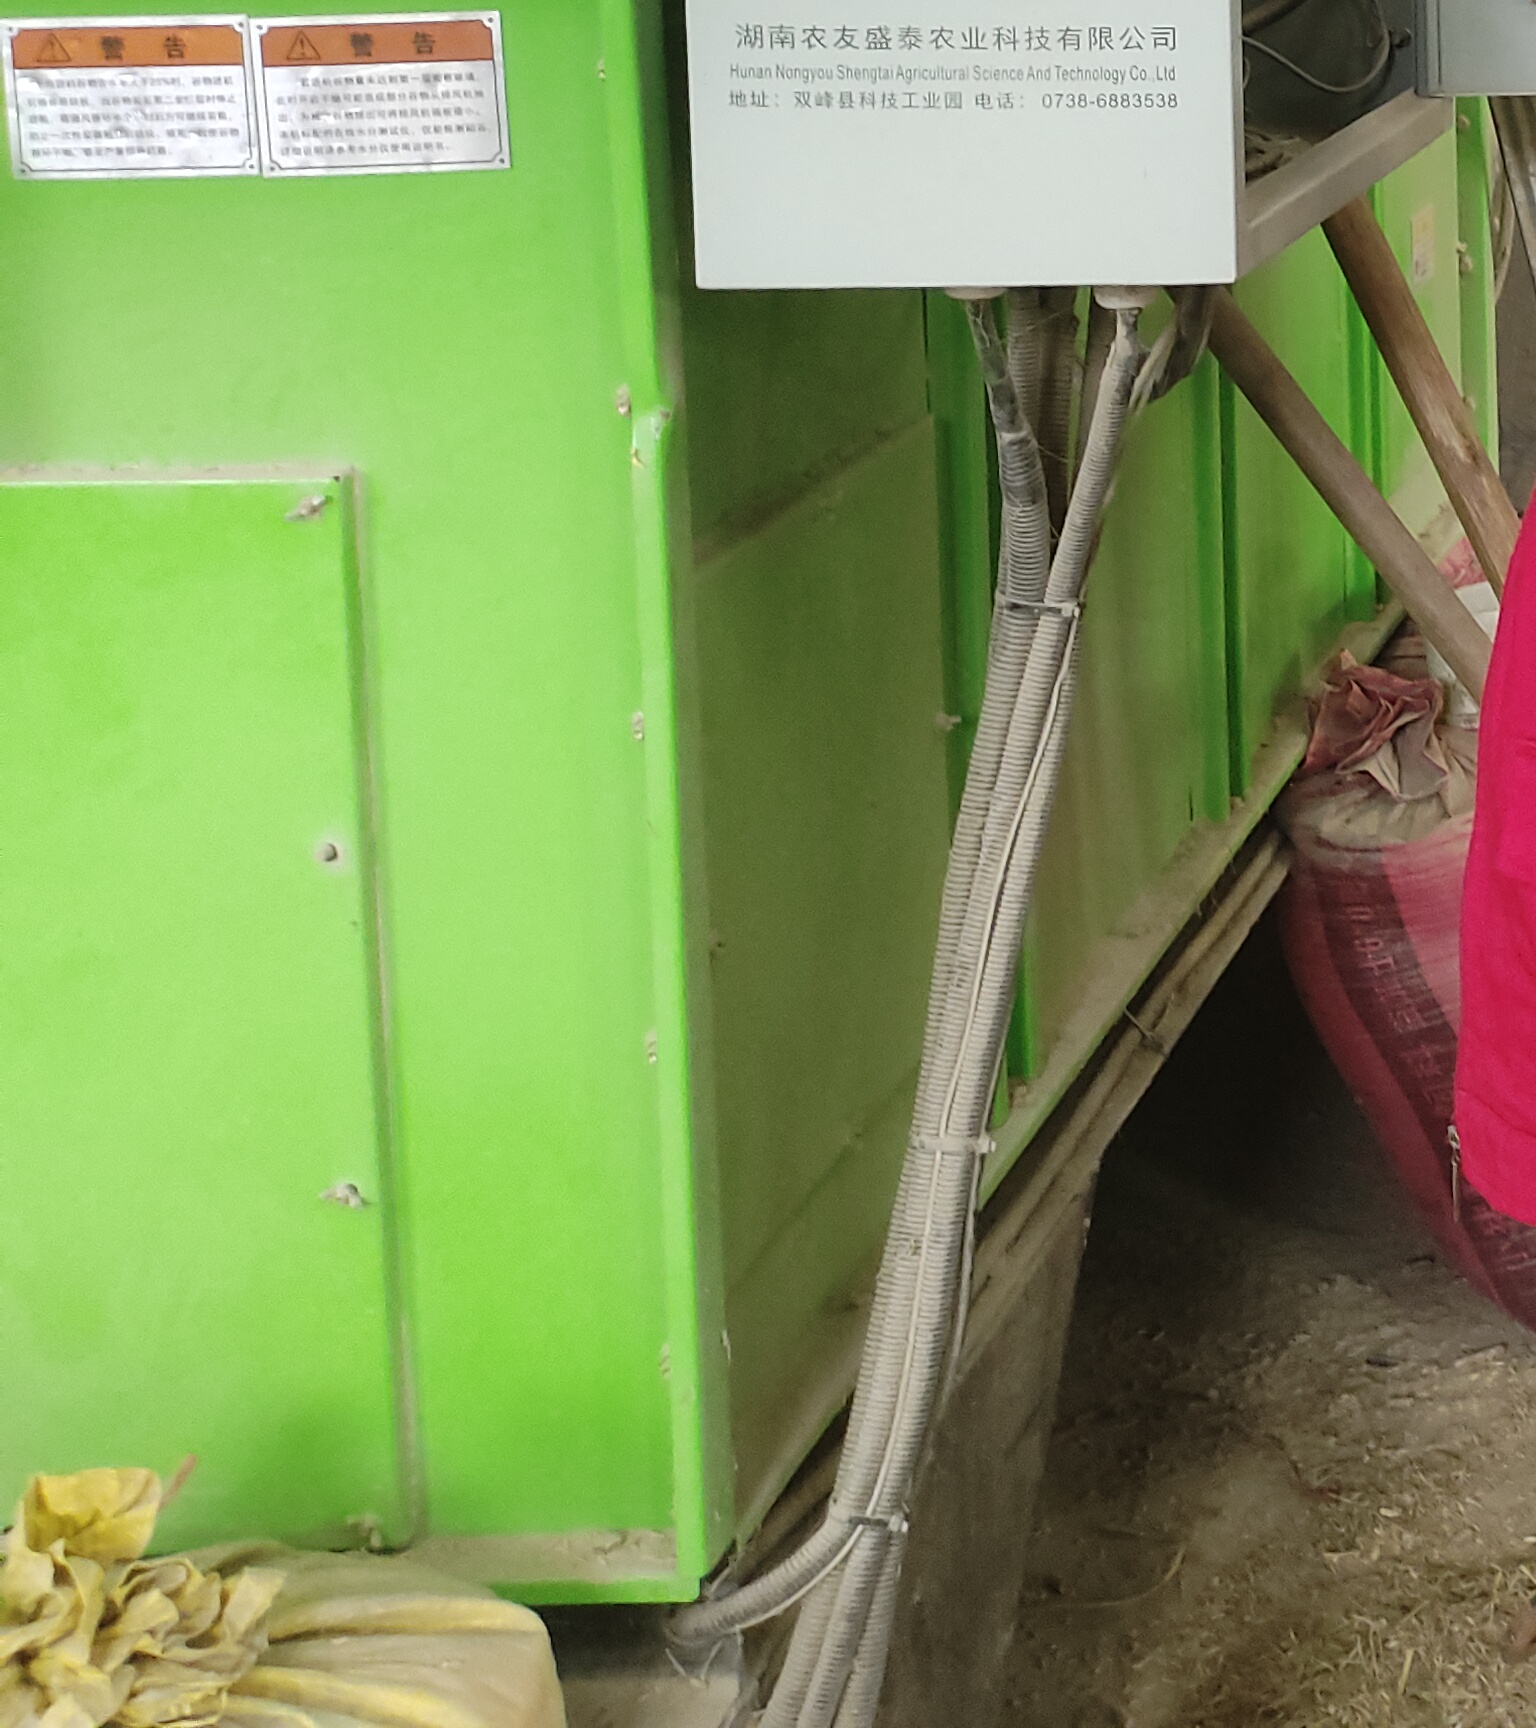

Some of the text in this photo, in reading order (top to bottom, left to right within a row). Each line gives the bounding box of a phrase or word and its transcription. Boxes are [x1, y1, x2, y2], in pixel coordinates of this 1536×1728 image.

[735, 23, 1177, 52] 湖南农友盛泰农业科技有限公司
[729, 64, 772, 80] Hunan
[776, 65, 834, 84] Nongyou
[836, 65, 894, 84] Shengtai
[896, 65, 969, 84] Agricultural
[973, 65, 1024, 81] Science
[1026, 66, 1051, 81] And
[1055, 65, 1126, 85] Technology
[1042, 93, 1178, 109] 0738-6883538
